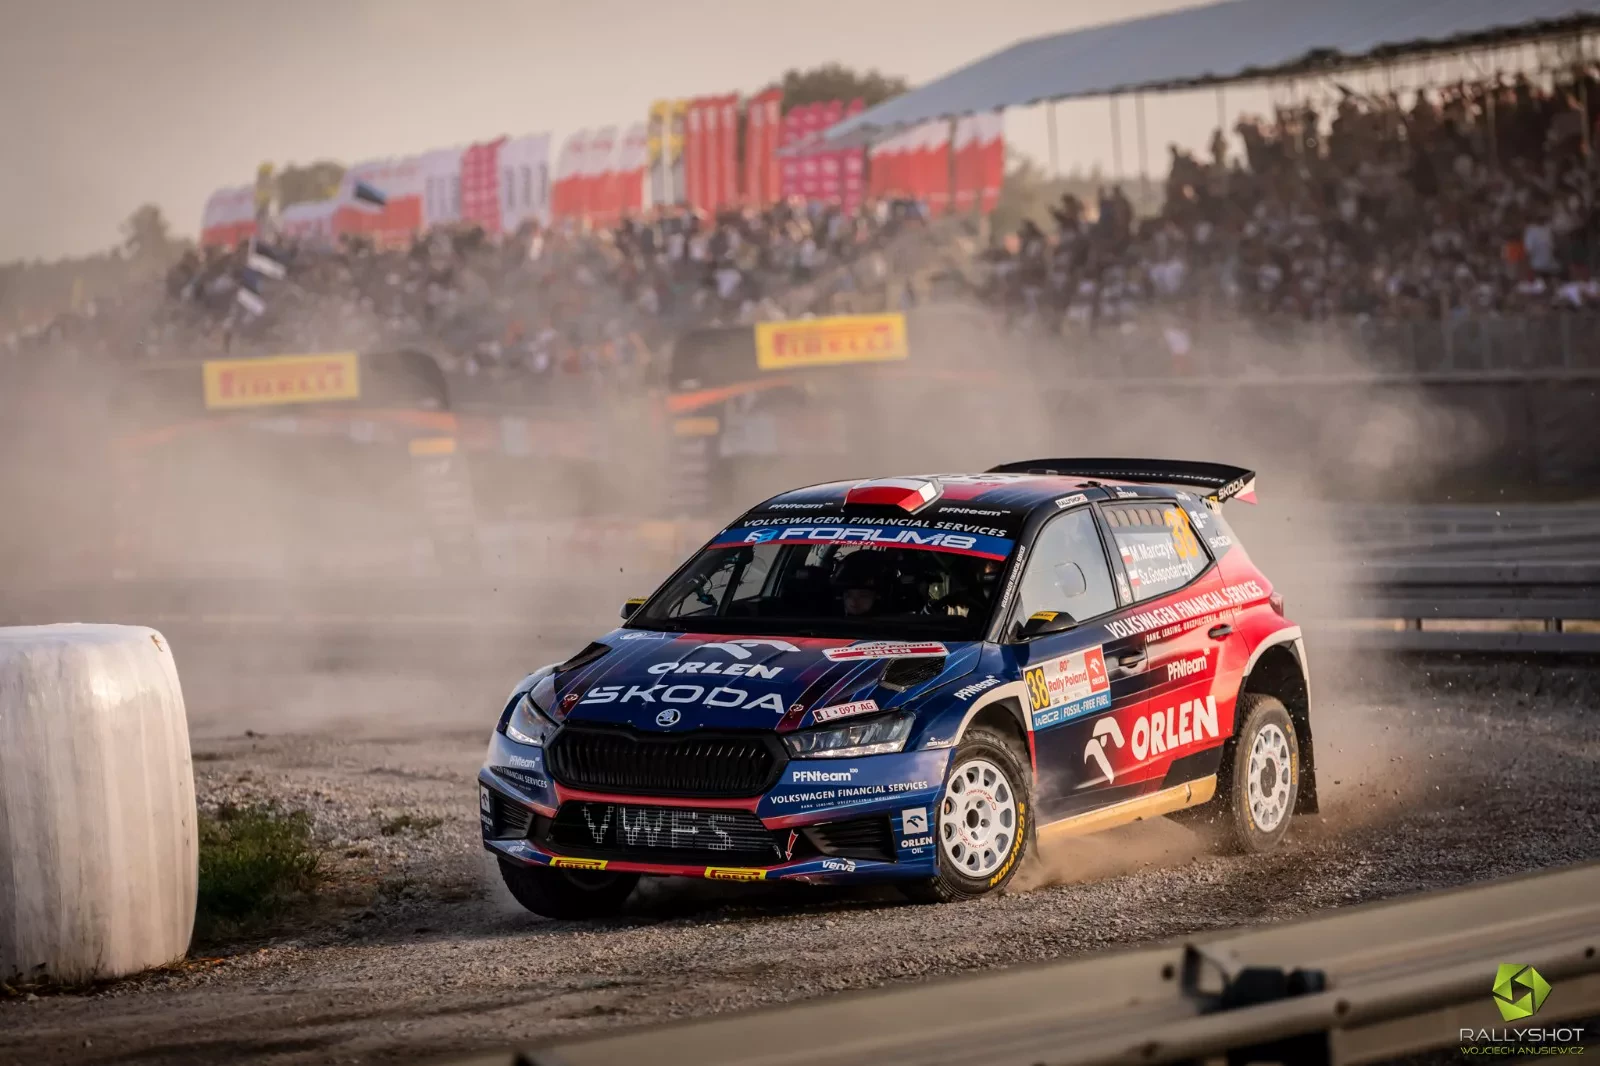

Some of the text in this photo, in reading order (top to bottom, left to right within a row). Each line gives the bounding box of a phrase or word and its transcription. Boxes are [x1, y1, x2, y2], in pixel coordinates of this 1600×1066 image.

[1218, 479, 1245, 500] SKODA
[744, 516, 1008, 537] VOLKSWAGEN FINANCIAL SERVICES
[779, 527, 977, 550] FORUM8
[1104, 580, 1265, 640] VOLKSWAGEN FINANCIAL SERVICES
[647, 661, 785, 680] ORLEN
[1167, 653, 1208, 682] PFNteam
[1026, 668, 1051, 710] 38
[1047, 669, 1088, 693] Rally Poland
[578, 684, 786, 714] SKODA
[1063, 699, 1096, 718] FOSSIL-FREE
[1095, 694, 1110, 707] FUEL
[1131, 695, 1220, 761] ORLEN
[524, 774, 548, 789] SERVICES
[792, 770, 852, 783] PFNteam
[771, 780, 928, 805] VOLKSWAGEN FINANCIAL SERVICES
[901, 836, 933, 848] ORLEN
[989, 801, 1026, 887] SCORPION
[822, 860, 857, 872] verva
